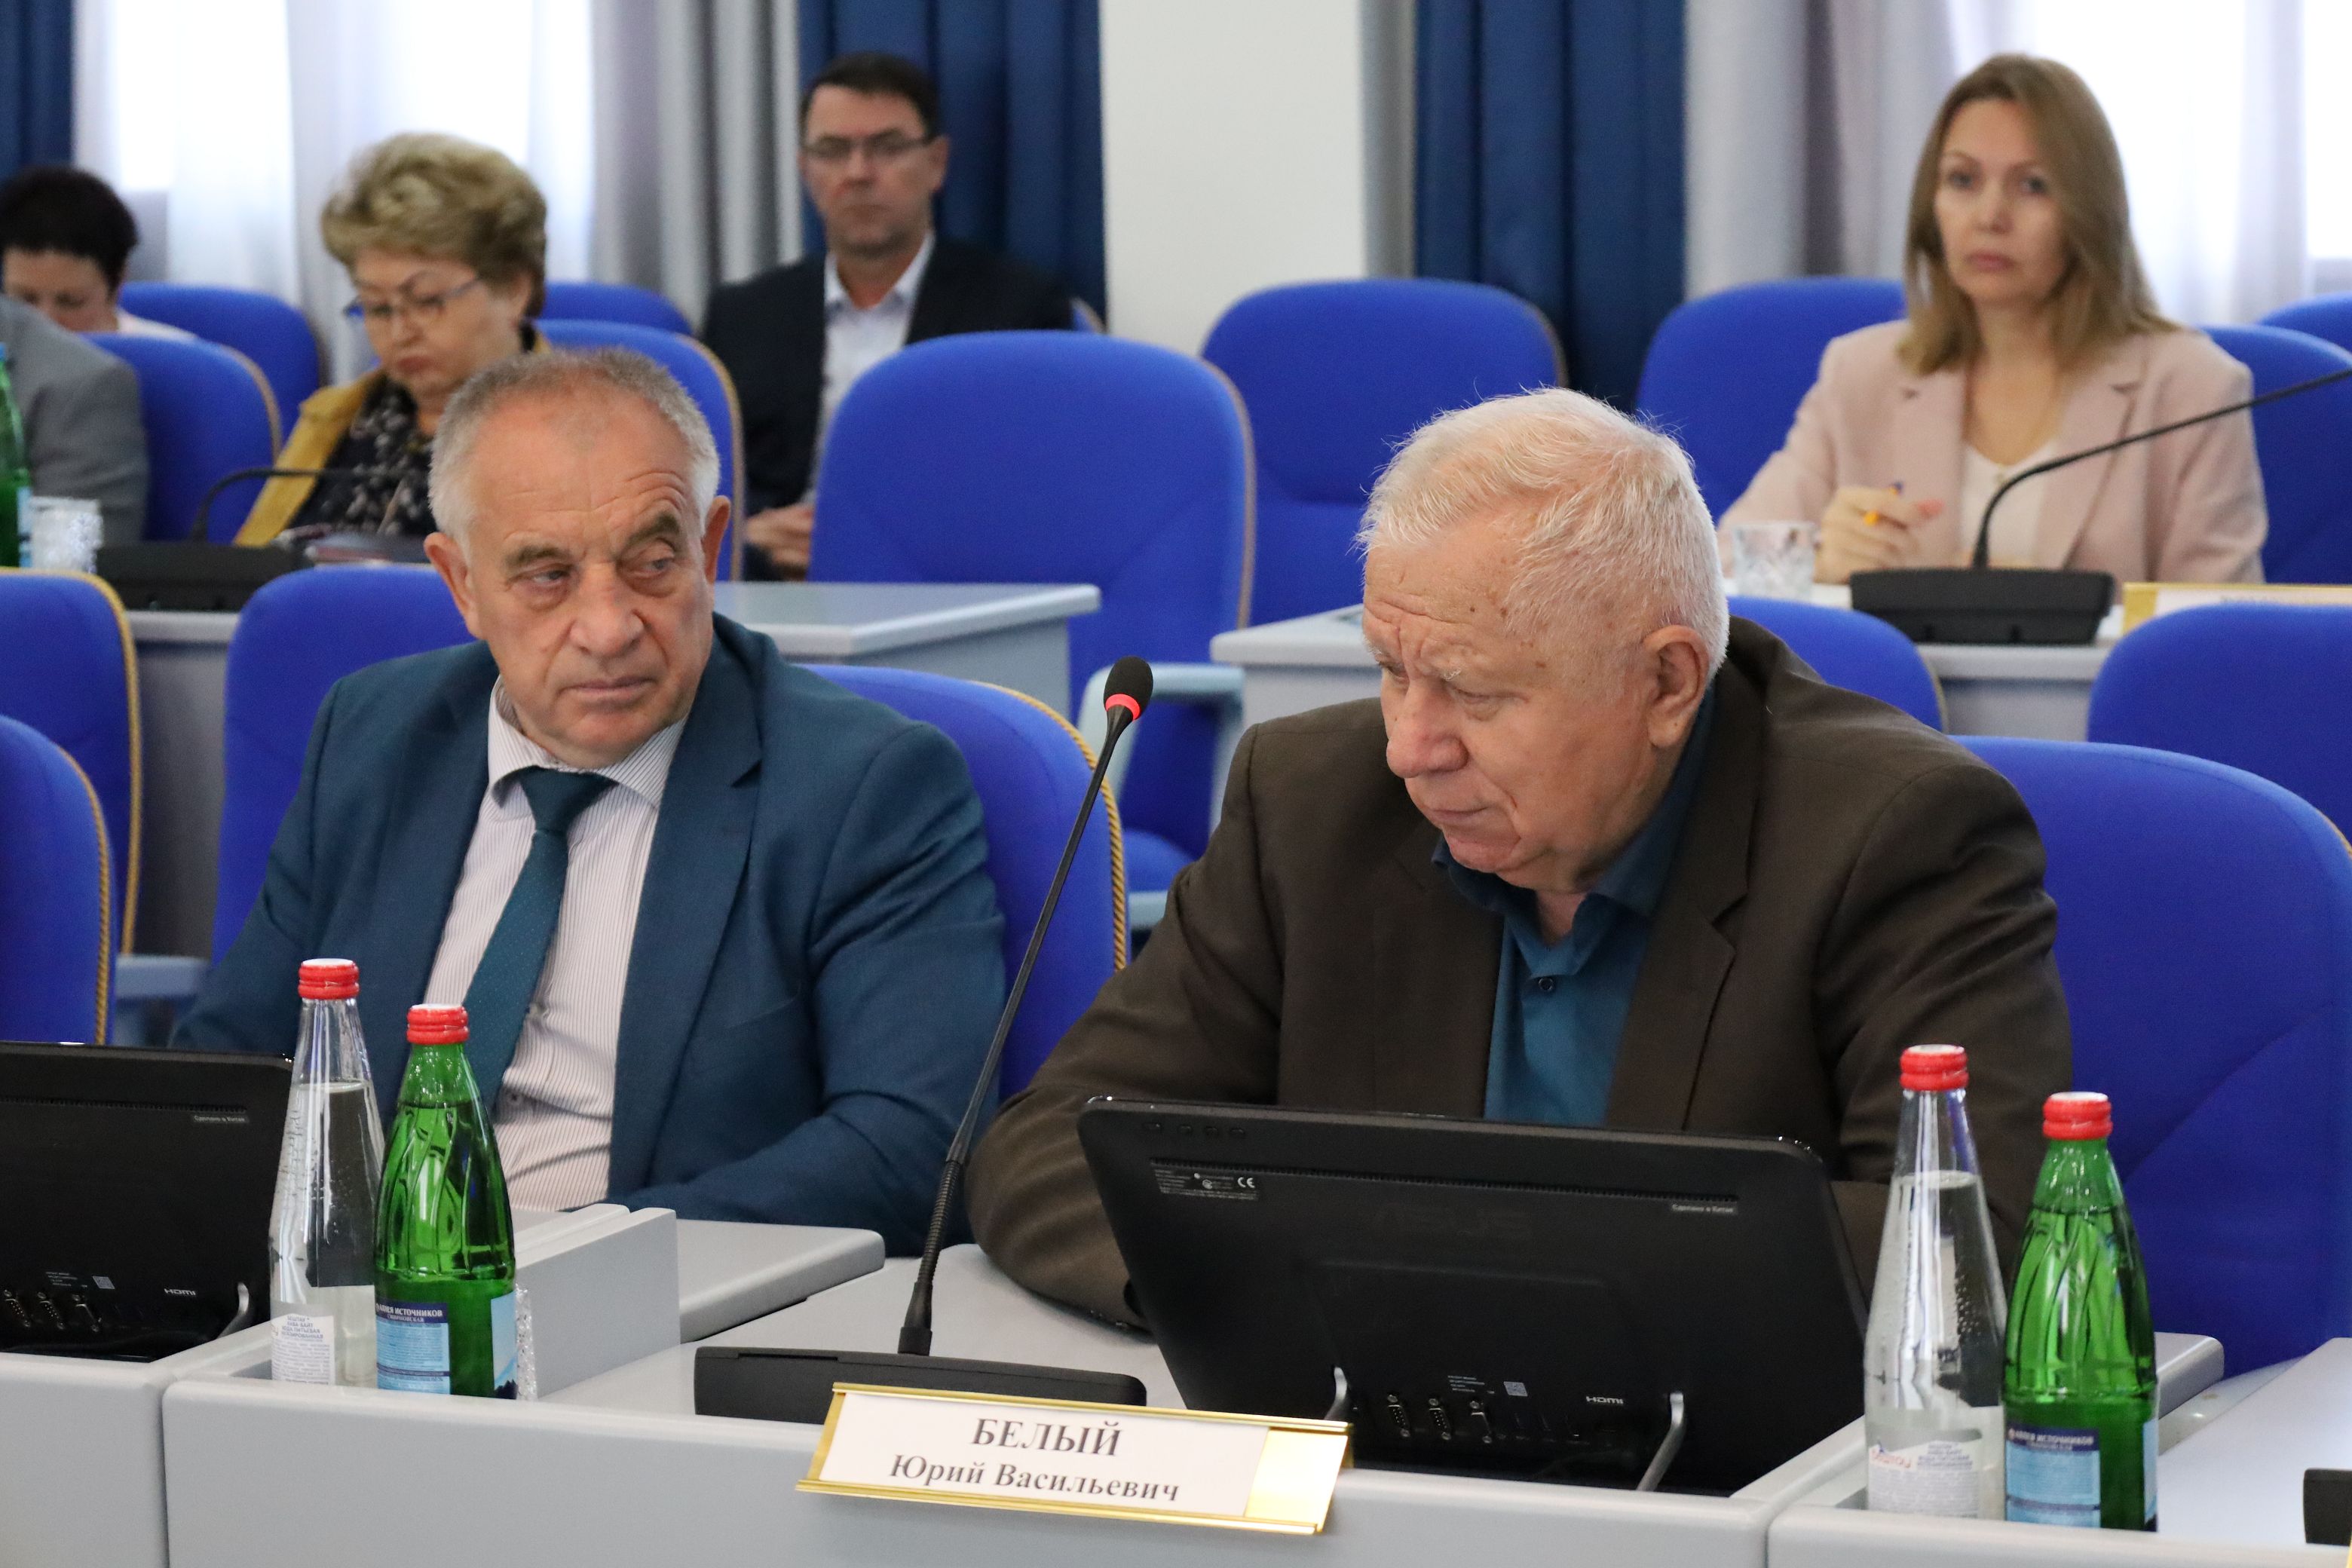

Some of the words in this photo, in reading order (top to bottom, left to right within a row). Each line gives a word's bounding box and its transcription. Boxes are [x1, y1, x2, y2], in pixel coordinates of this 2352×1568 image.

[394, 1308, 443, 1317] ИСТОЧНИКОВ
[1585, 1396, 1624, 1404] HDMI
[970, 1418, 1122, 1456] БЕЛЫЙ
[890, 1454, 985, 1487] Юрий
[994, 1463, 1179, 1502] Васильевич
